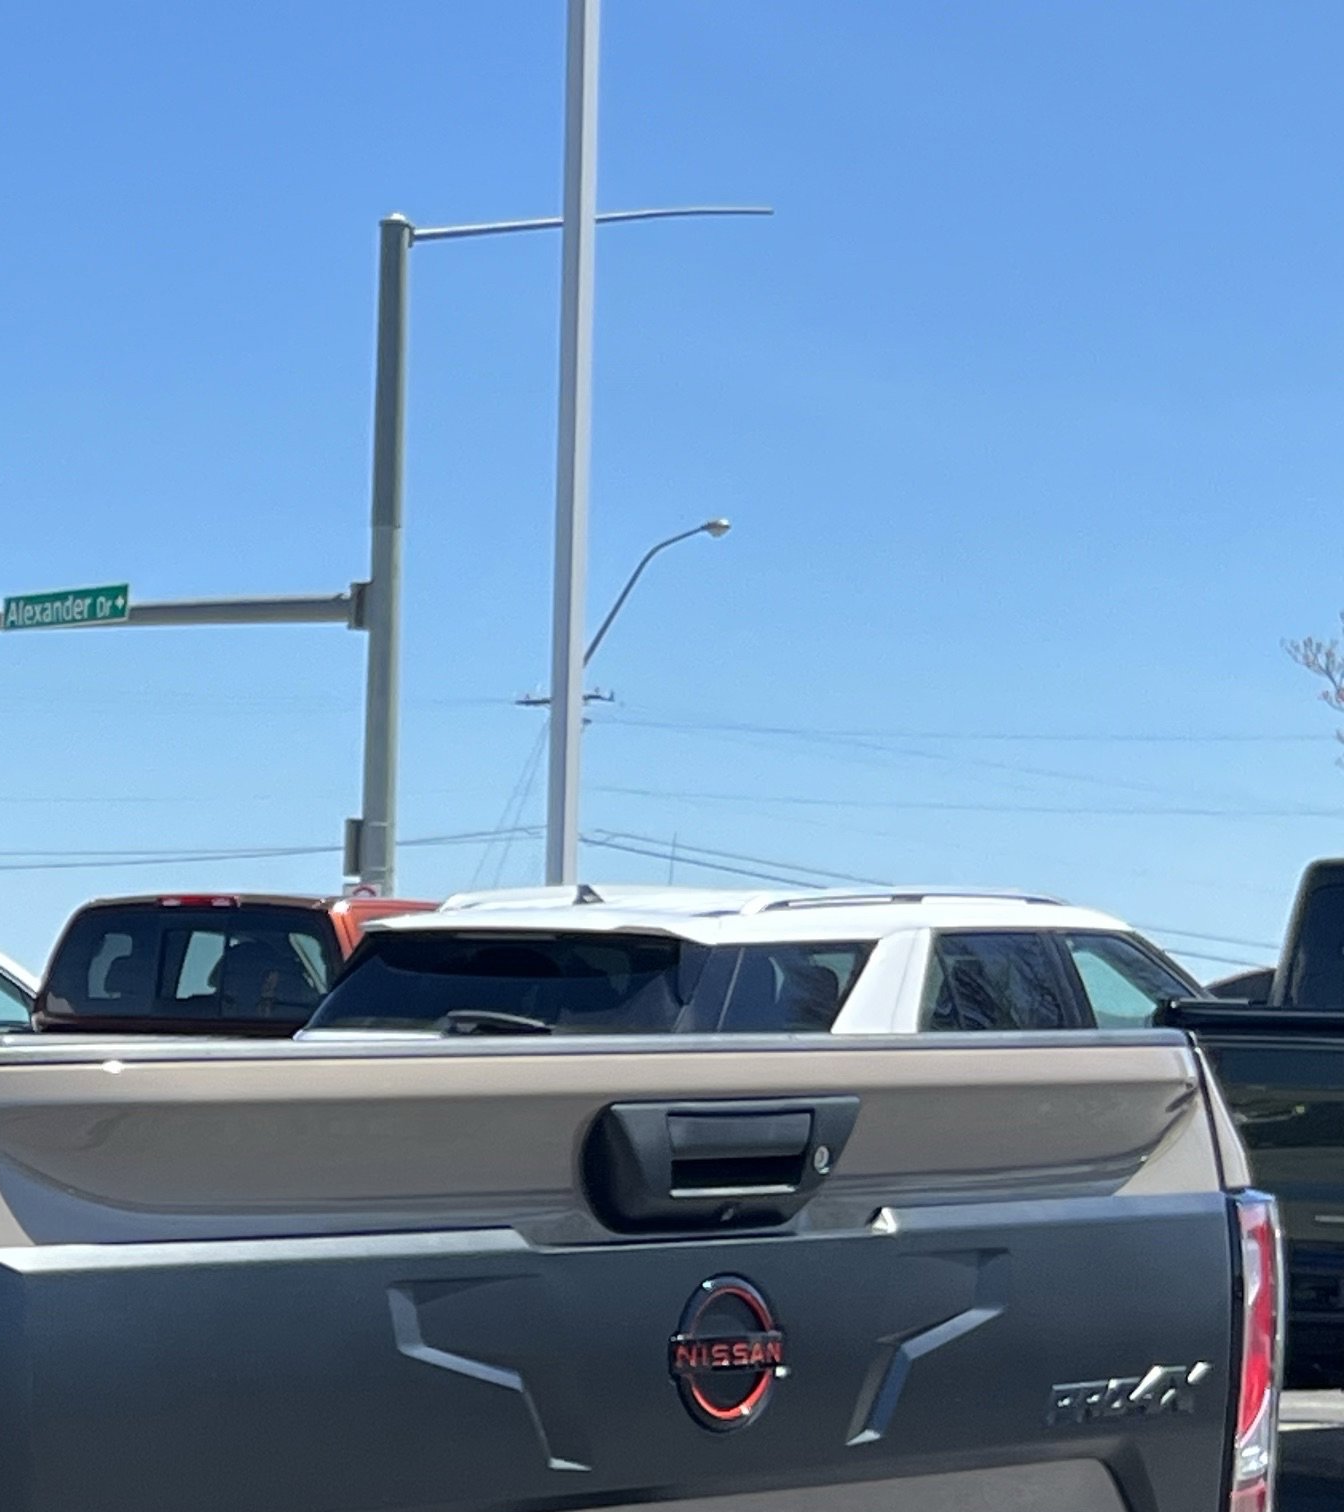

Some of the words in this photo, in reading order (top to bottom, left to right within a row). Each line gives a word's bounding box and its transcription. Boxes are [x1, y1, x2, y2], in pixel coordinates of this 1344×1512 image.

[7, 595, 91, 626] Alexander
[96, 596, 112, 617] Dr
[675, 1341, 784, 1368] NISSAN
